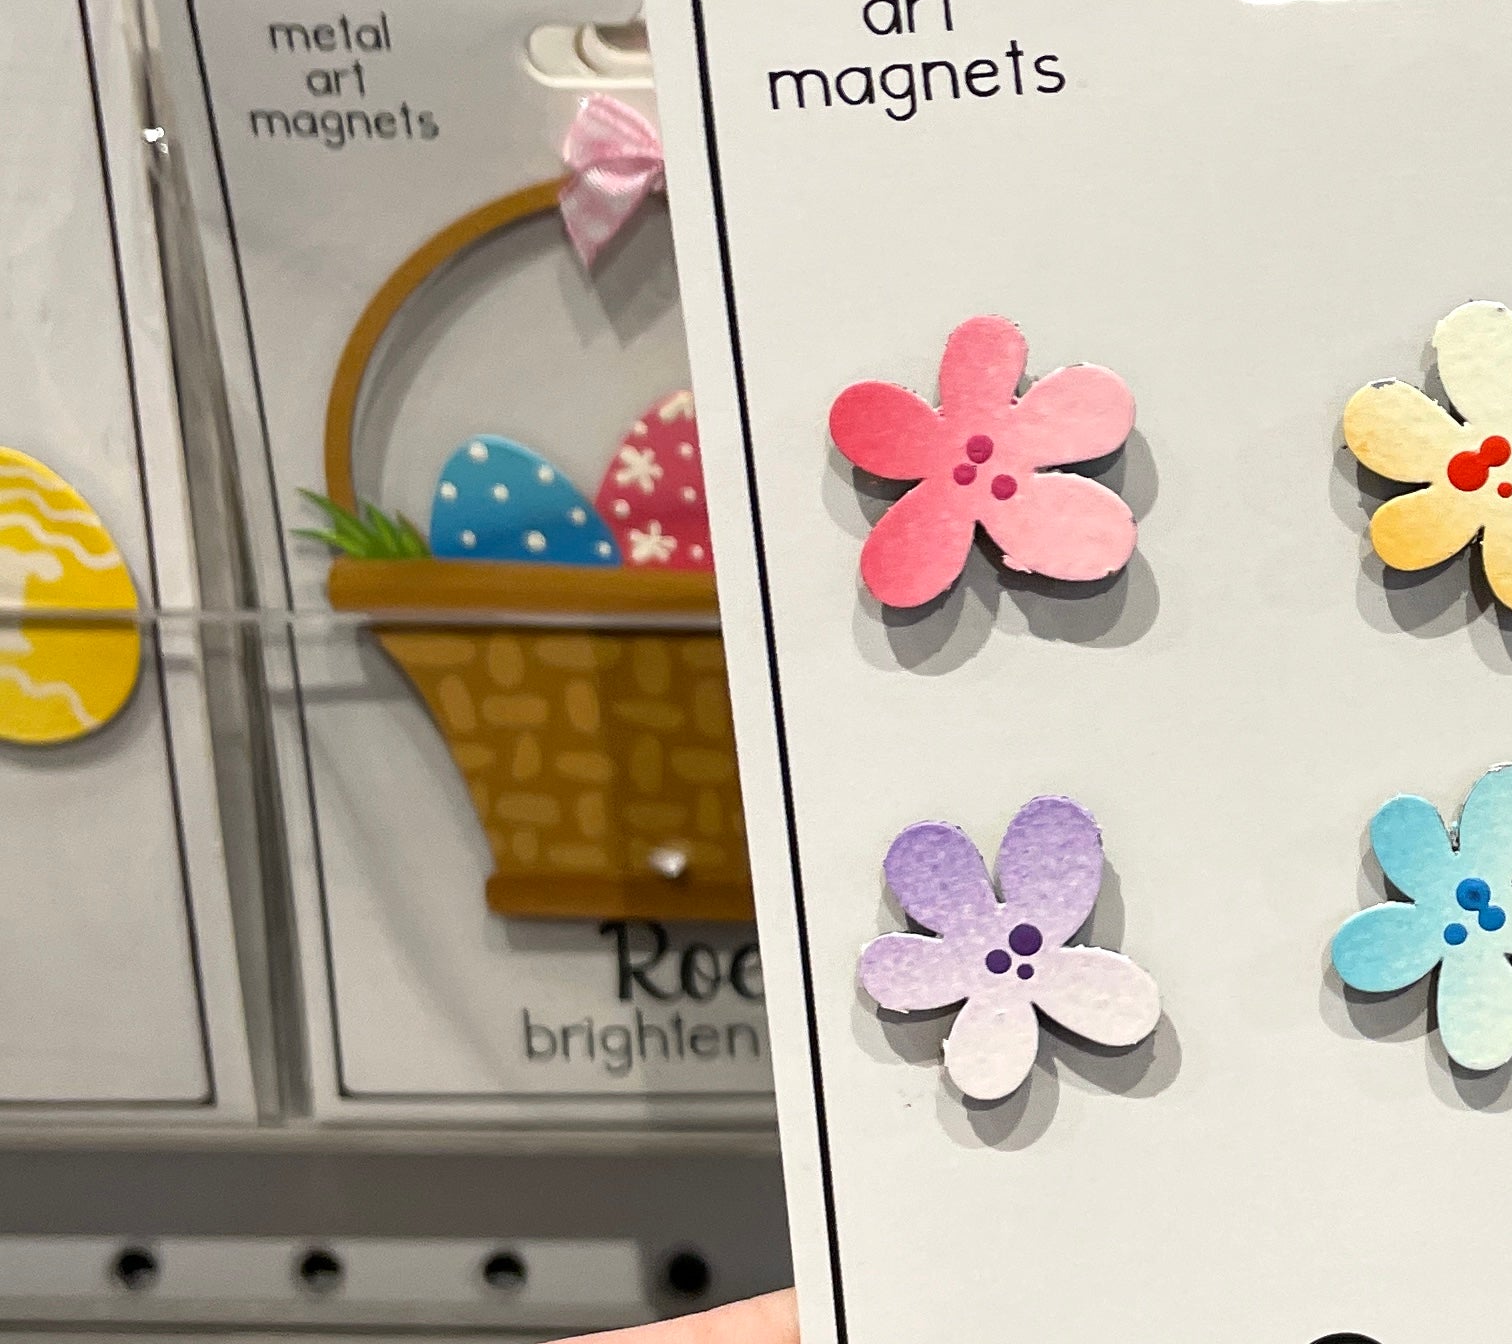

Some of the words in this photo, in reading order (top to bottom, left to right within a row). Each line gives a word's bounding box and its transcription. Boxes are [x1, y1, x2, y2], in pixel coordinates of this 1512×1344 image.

[268, 11, 392, 53] metal
[306, 58, 366, 97] art
[768, 40, 1067, 122] magnets
[249, 102, 440, 149] magnets
[599, 918, 765, 1002] Roe
[522, 1007, 761, 1078] brighten
